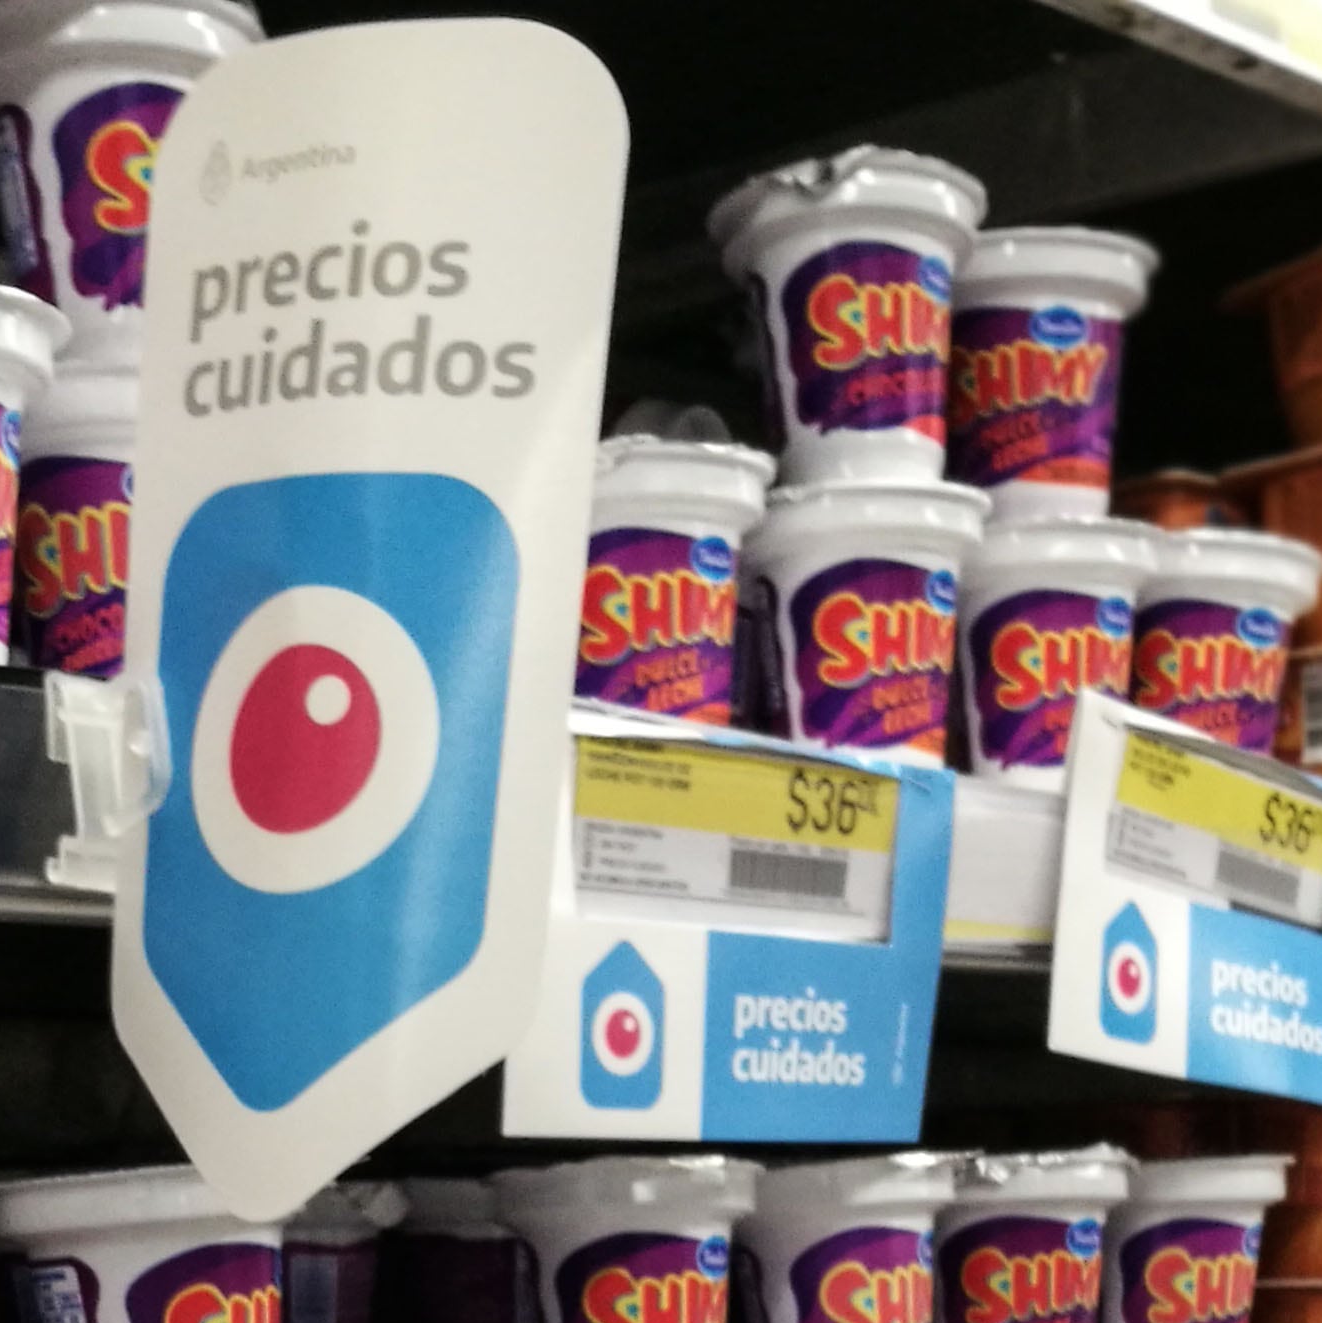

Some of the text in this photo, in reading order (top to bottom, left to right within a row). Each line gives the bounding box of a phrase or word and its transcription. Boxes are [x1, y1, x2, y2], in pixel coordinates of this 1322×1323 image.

[240, 144, 356, 184] Argentina
[190, 219, 471, 343] precios
[184, 314, 537, 418] cuidados
[22, 502, 129, 619] SHI
[579, 564, 737, 664] SHIM
[735, 987, 846, 1037] precios
[1210, 959, 1307, 1006] precios
[732, 1041, 866, 1086] cuidados
